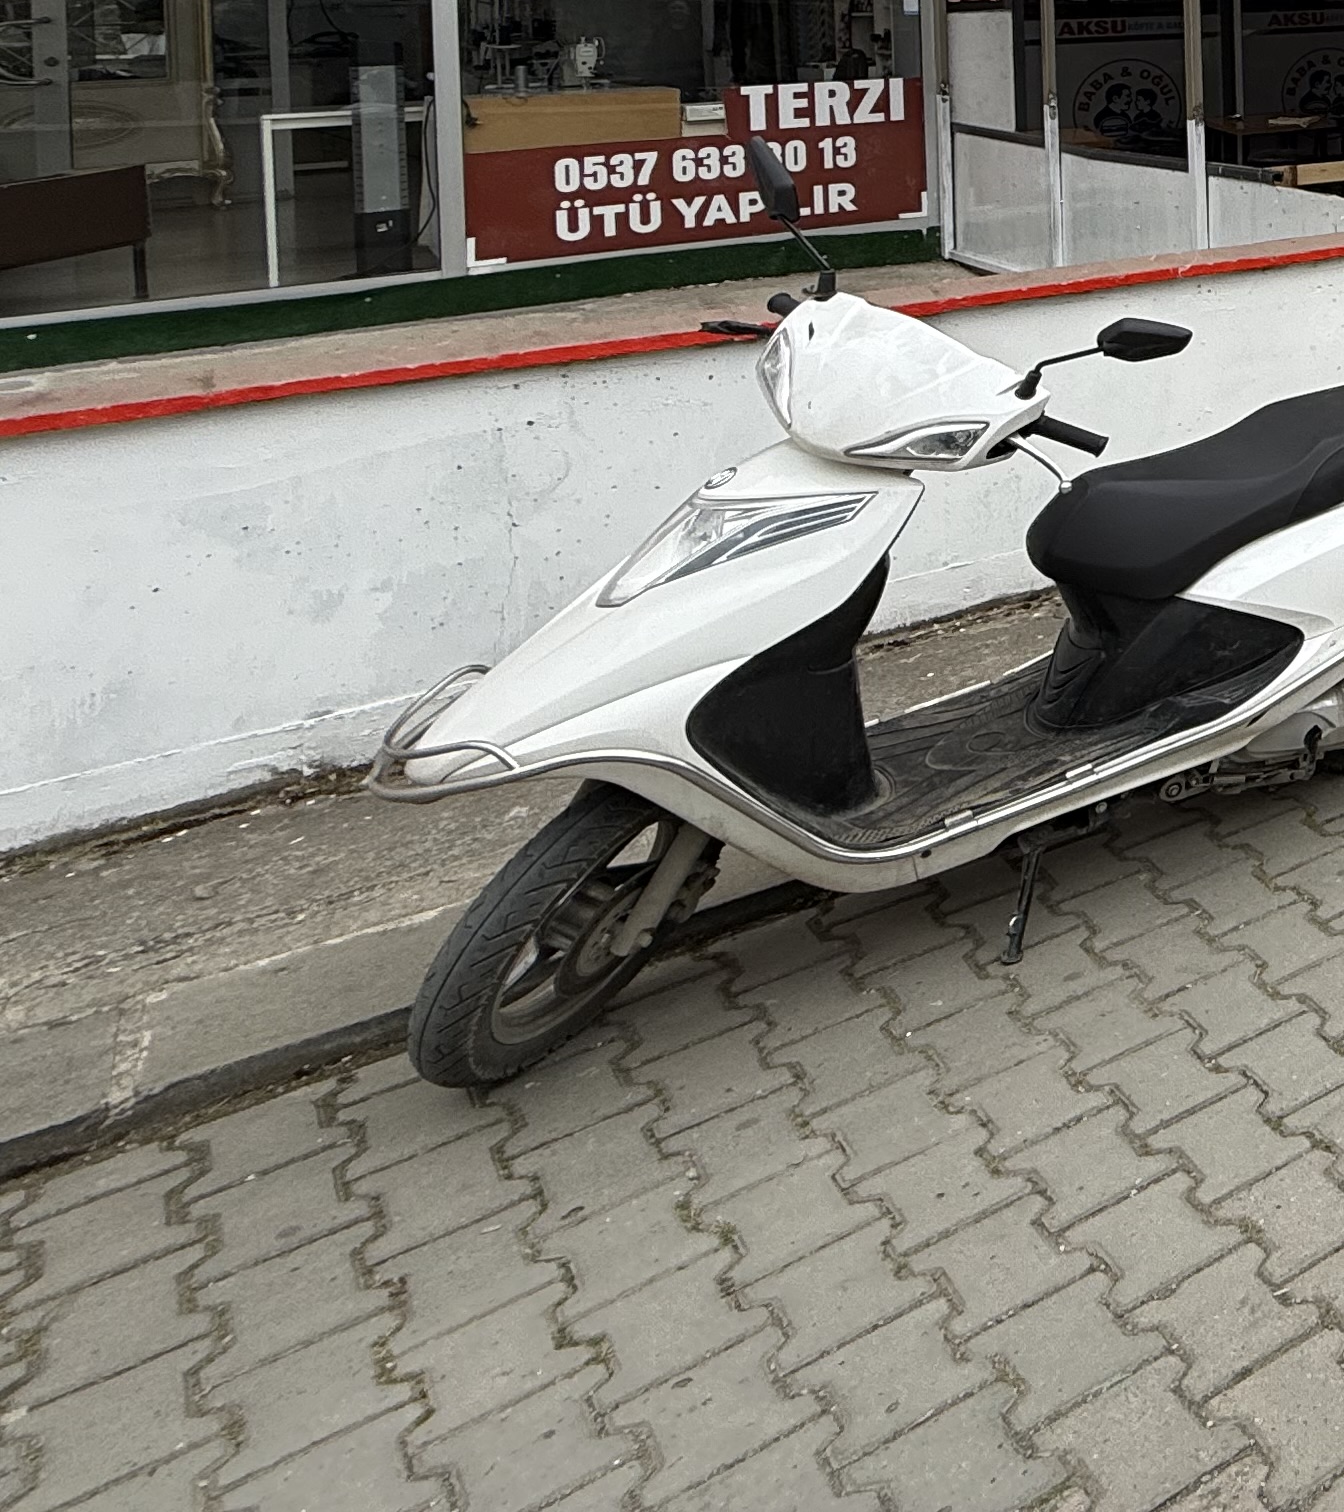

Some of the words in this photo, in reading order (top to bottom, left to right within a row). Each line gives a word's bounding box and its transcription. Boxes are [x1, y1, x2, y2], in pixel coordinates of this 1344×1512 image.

[1059, 19, 1127, 37] AKSU
[1267, 11, 1325, 27] AKSU
[1078, 72, 1115, 113] BABA
[1120, 66, 1132, 77] &
[1139, 69, 1176, 106] OĞUL
[1286, 59, 1317, 97] BABA
[1321, 55, 1331, 65] &
[740, 77, 905, 132] TERZI
[554, 151, 659, 194] 0537
[672, 144, 746, 183] 633
[818, 135, 857, 169] 13
[555, 191, 662, 242] ÜTÜ
[671, 182, 859, 230] YAPIR
